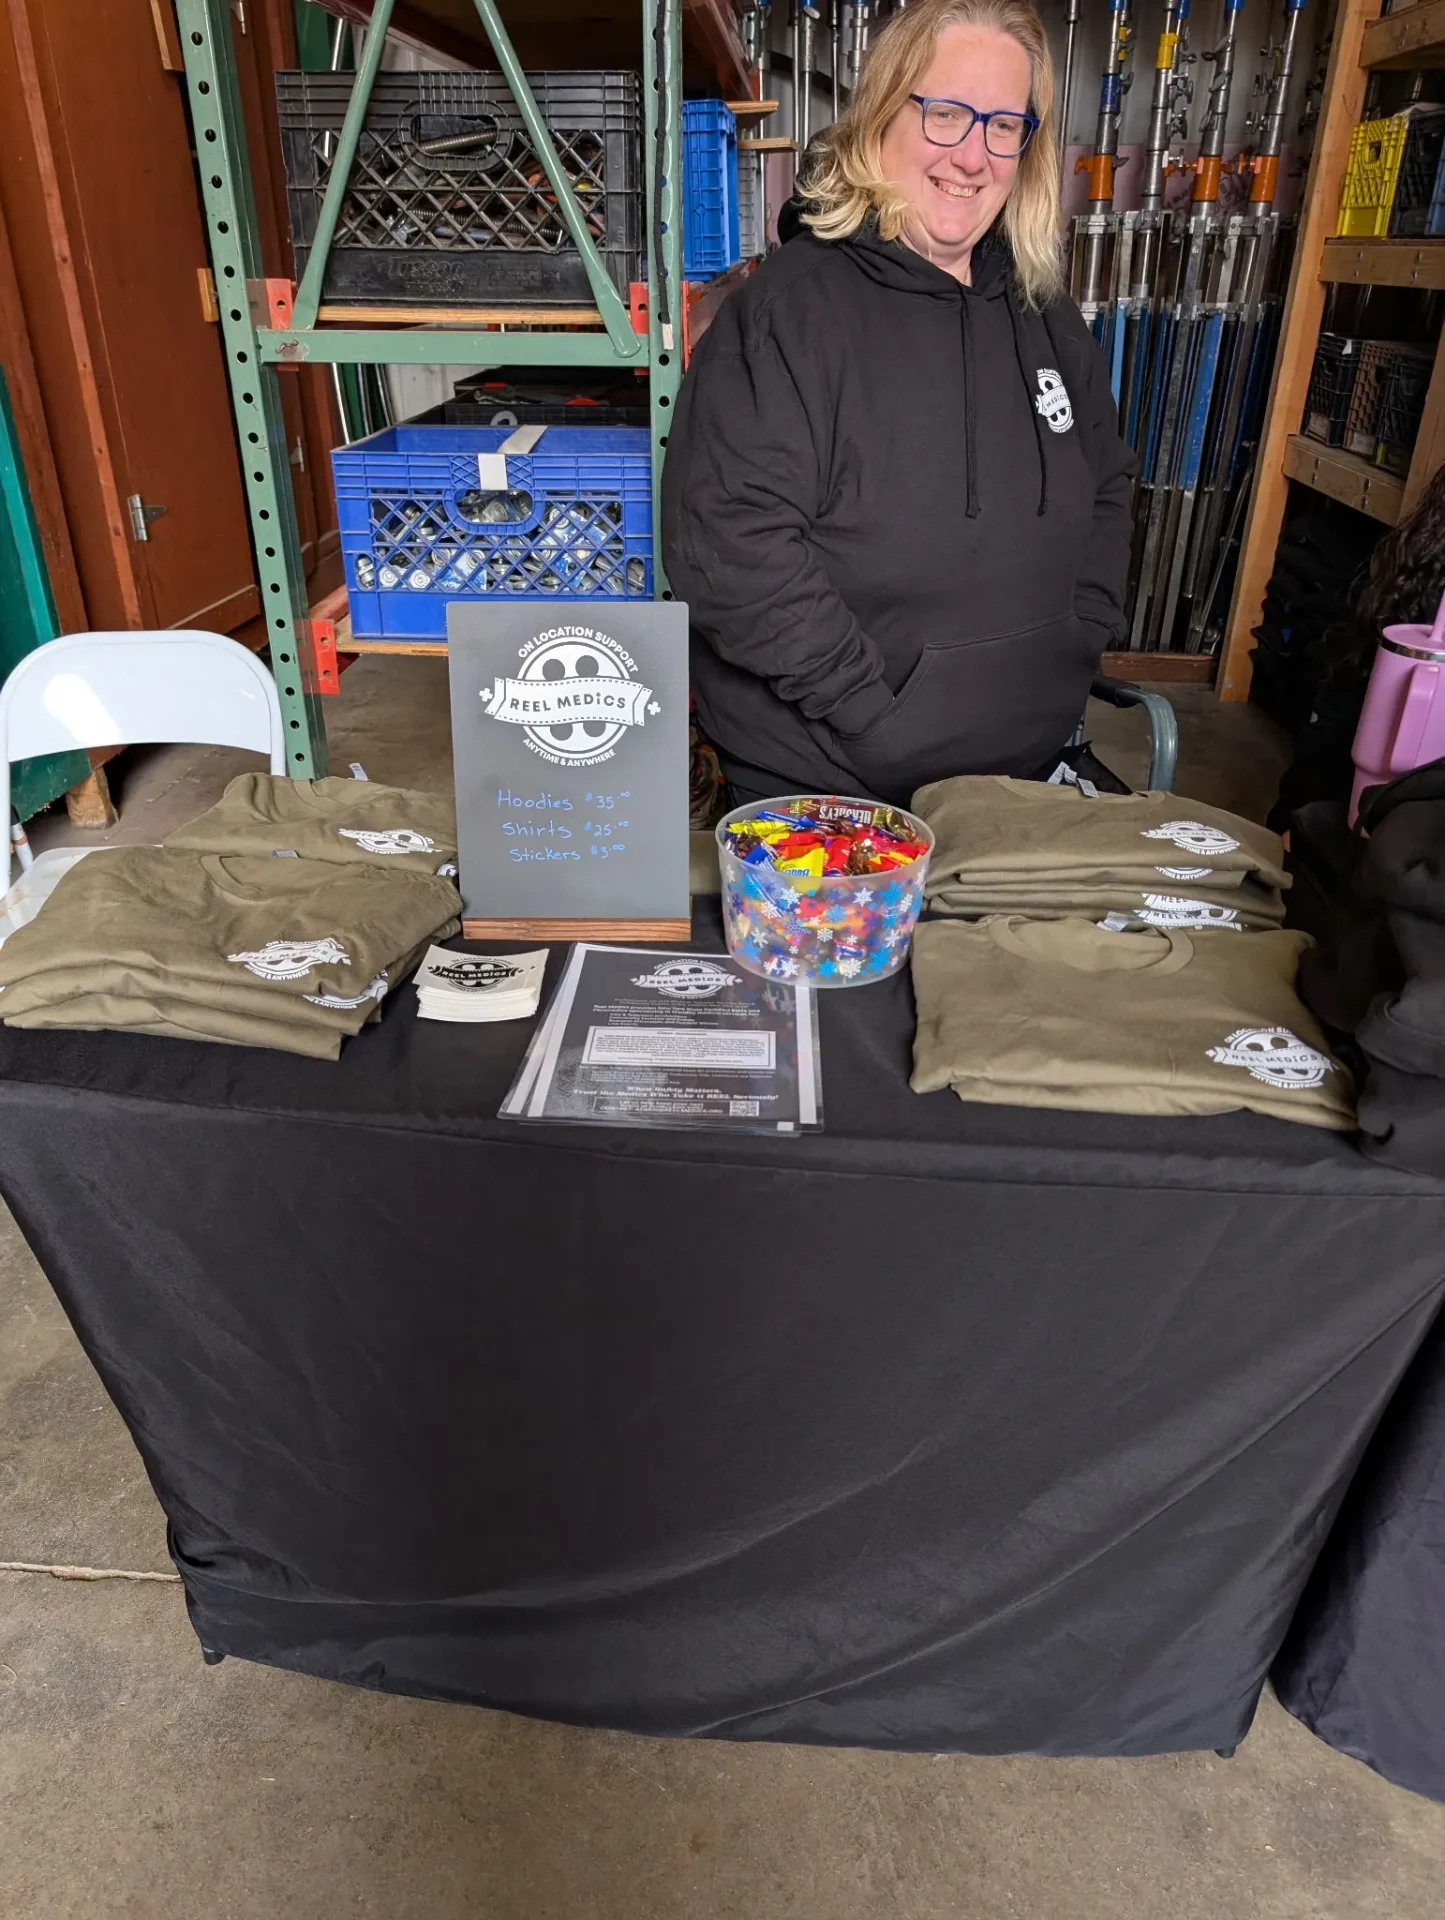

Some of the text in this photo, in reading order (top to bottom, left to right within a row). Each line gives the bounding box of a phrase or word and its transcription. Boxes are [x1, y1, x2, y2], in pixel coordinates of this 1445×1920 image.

[518, 626, 639, 673] ON LOCATION SUPPORT
[509, 692, 626, 713] REEL MEDiCS
[522, 738, 617, 767] ANYTIME & ANYWHERE
[498, 788, 574, 811] Hoodies
[502, 820, 572, 839] Shirts
[509, 845, 581, 862] Stickers
[271, 968, 311, 981] ANYWHERE
[442, 969, 466, 979] REEL
